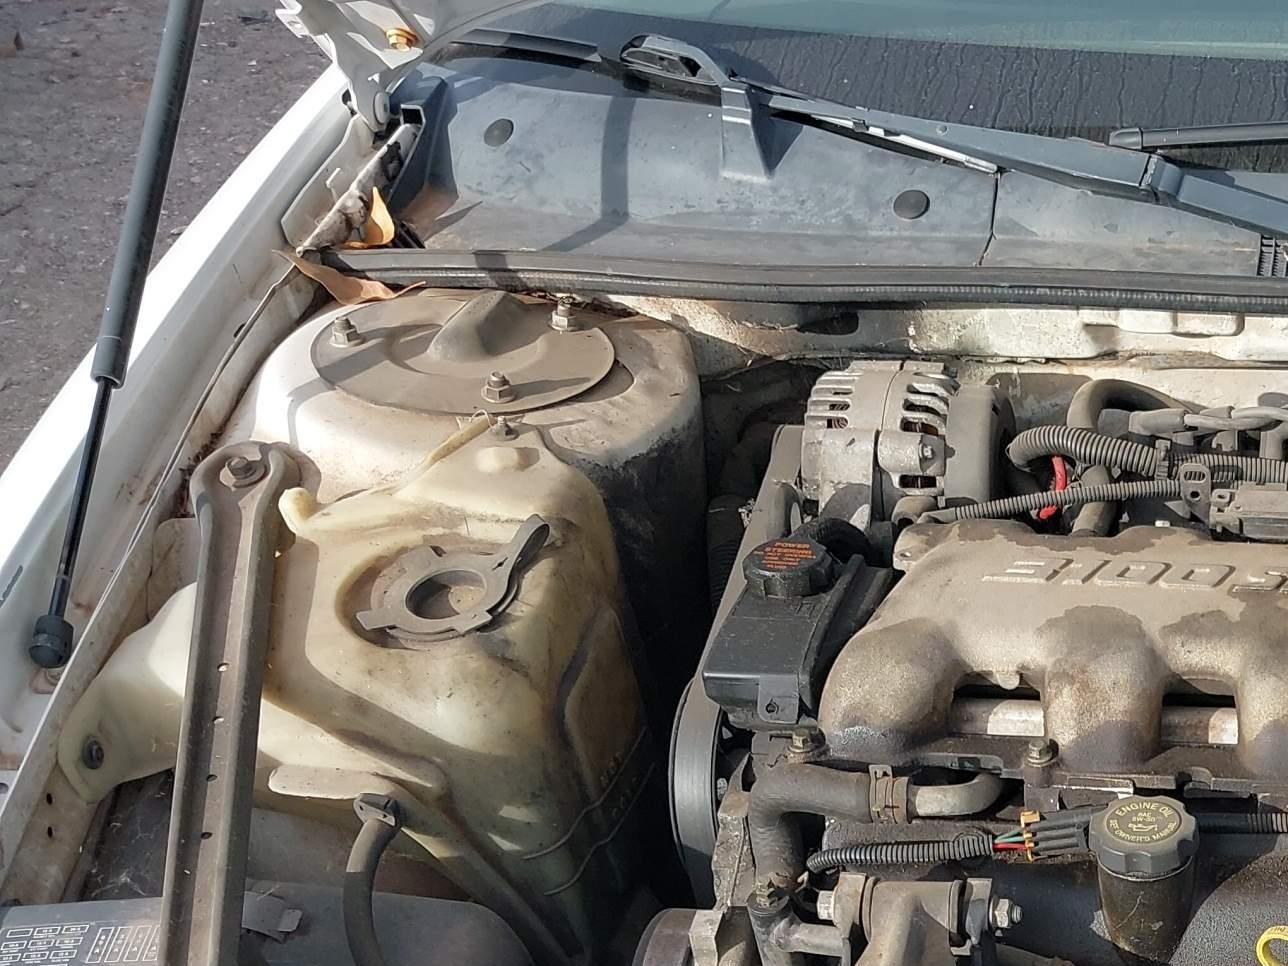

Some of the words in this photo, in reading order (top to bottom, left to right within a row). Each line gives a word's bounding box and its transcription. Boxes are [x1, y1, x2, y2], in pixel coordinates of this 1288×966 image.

[982, 557, 1237, 589] 3100
[1115, 801, 1160, 817] ENGINE
[1159, 805, 1175, 818] OIL
